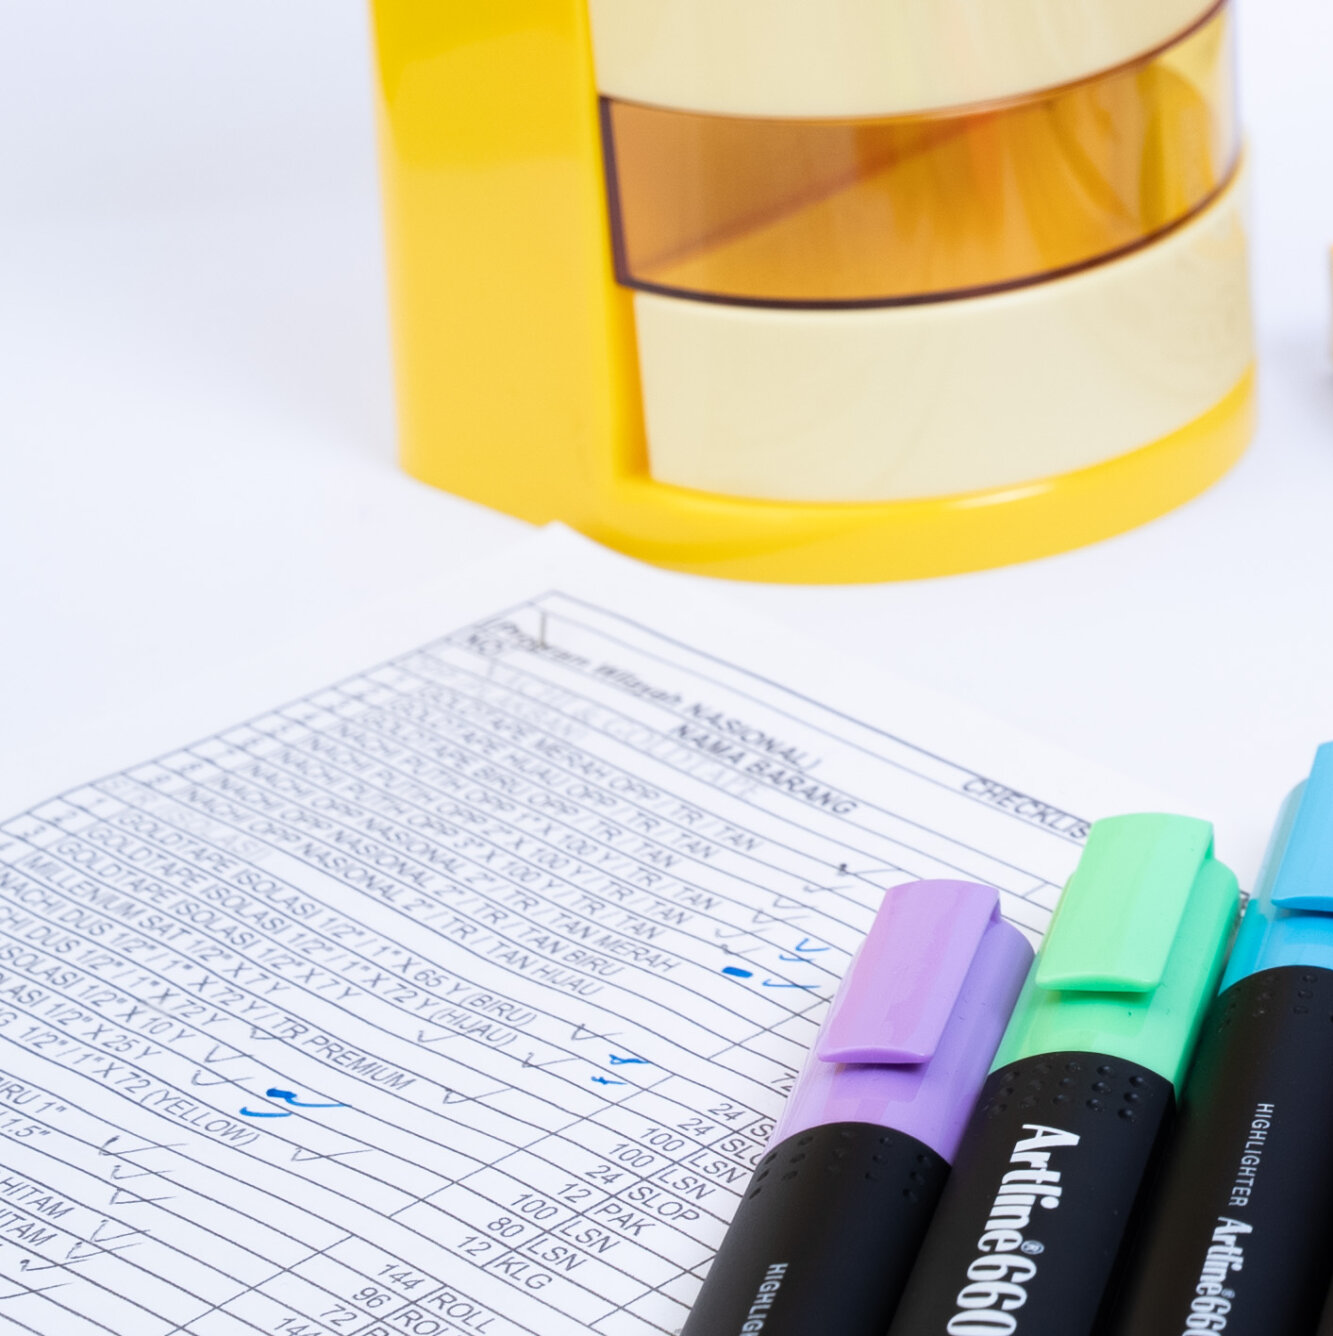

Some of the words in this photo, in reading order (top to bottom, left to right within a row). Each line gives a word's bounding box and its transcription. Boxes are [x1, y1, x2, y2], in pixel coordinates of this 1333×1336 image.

[746, 763, 858, 817] BARANG
[962, 777, 1089, 839] CHECKLIS
[632, 842, 682, 868] TAN
[670, 833, 721, 858] TAN
[714, 825, 764, 852] TAN
[170, 899, 262, 952] ISOLASI
[297, 842, 406, 904] NASIONAL
[440, 916, 478, 940] TR
[486, 940, 543, 972] TAN
[530, 964, 604, 997] HIJAU
[641, 900, 693, 926] TAN
[672, 886, 722, 911] TAN
[138, 913, 193, 943] SAT
[231, 867, 323, 921] ISOLASI
[413, 968, 449, 989] 65
[459, 992, 538, 1027] (BIRU)
[471, 902, 509, 925] TR
[516, 925, 570, 955] TAN
[561, 948, 626, 978] BIRU
[503, 889, 540, 911] TR
[546, 912, 601, 940] TAN
[593, 934, 682, 973] MERAH
[611, 915, 667, 940] TAN
[25, 925, 81, 955] DUS
[170, 1000, 206, 1021] 72
[200, 883, 292, 935] ISOLASI
[382, 983, 418, 1005] 72
[428, 1007, 518, 1050] (HIJAU)
[59, 907, 113, 937] DUS
[210, 983, 244, 1006] 72
[271, 1016, 308, 1040] TR
[302, 1035, 416, 1091] PREMIUM
[139, 1017, 173, 1036] 10
[82, 1023, 113, 1041] X
[102, 1033, 140, 1054] 25
[134, 1046, 162, 1062] Y
[92, 1062, 126, 1080] X
[115, 1070, 152, 1094] 72
[138, 1088, 260, 1148] (YELLOW)
[707, 1102, 746, 1122] 24
[641, 1127, 686, 1153] 100
[688, 1152, 748, 1184] LSN
[676, 1117, 715, 1137] 24
[720, 1138, 763, 1166] SL
[1228, 1102, 1275, 1207] HIGHLIGHTER
[0, 1176, 76, 1220] HITAM
[584, 1164, 624, 1185] 24
[628, 1186, 700, 1222] SLOP
[609, 1142, 656, 1168] 100
[657, 1168, 716, 1200] LSN
[510, 1193, 559, 1221] 100
[557, 1220, 620, 1254] LSN
[557, 1180, 592, 1204] 12
[594, 1202, 656, 1237] PAK
[457, 1235, 492, 1257] 12
[494, 1256, 553, 1291] KLG
[487, 1217, 525, 1239] 80
[526, 1237, 587, 1274] LSN
[320, 1304, 358, 1327] 72
[352, 1286, 392, 1309] 96
[394, 1309, 449, 1336] RO
[377, 1263, 425, 1291] 144
[427, 1291, 496, 1335] ROLL
[740, 1263, 789, 1336] HIGHLIG
